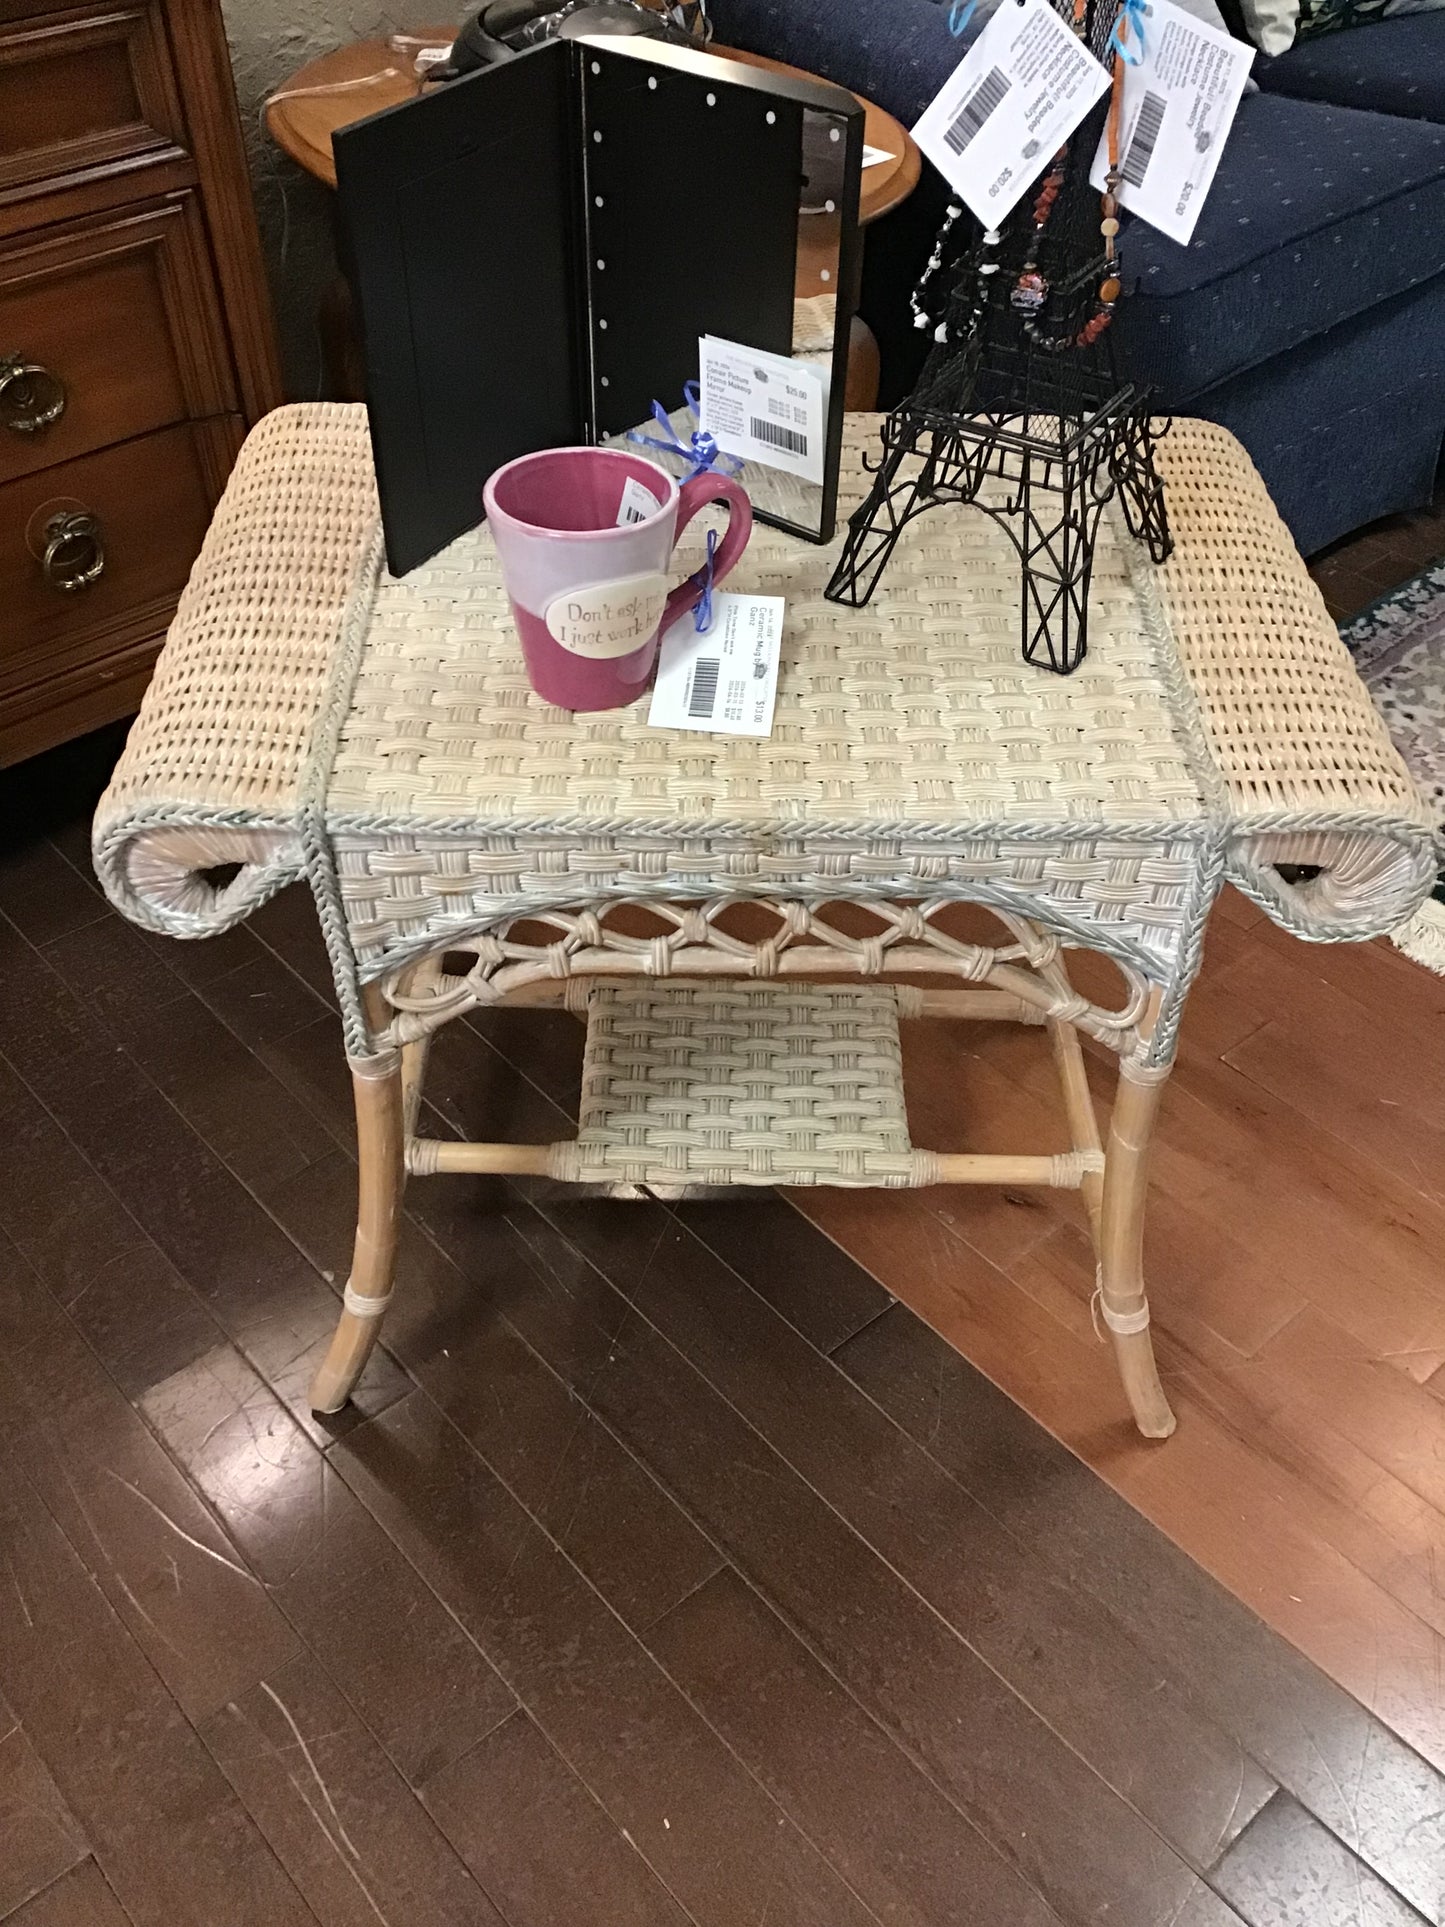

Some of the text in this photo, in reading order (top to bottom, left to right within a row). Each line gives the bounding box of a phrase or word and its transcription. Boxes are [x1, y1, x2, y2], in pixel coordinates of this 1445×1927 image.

[1040, 40, 1072, 81] Necklace
[1189, 38, 1210, 86] Necklace
[1021, 47, 1080, 121] Costume Jewelry
[1027, 56, 1087, 134] Beautiful! Beaded
[1184, 43, 1219, 130] Costume Jewelry
[1193, 48, 1228, 140] Beautiful! Beaded
[987, 165, 1013, 198] $20.00
[1174, 181, 1194, 217] $20.00
[706, 372, 751, 396] Frame Makeup
[706, 381, 724, 394] Mirror
[727, 372, 748, 385] Picture
[785, 384, 807, 400] $25.00
[567, 601, 611, 623] Don't
[616, 596, 642, 617] ask
[748, 605, 758, 626] Ganz
[559, 626, 566, 641] I
[568, 625, 603, 648] just
[606, 617, 643, 641] work
[751, 606, 767, 666] Ceramic Mug by
[752, 700, 765, 723] $13.00
